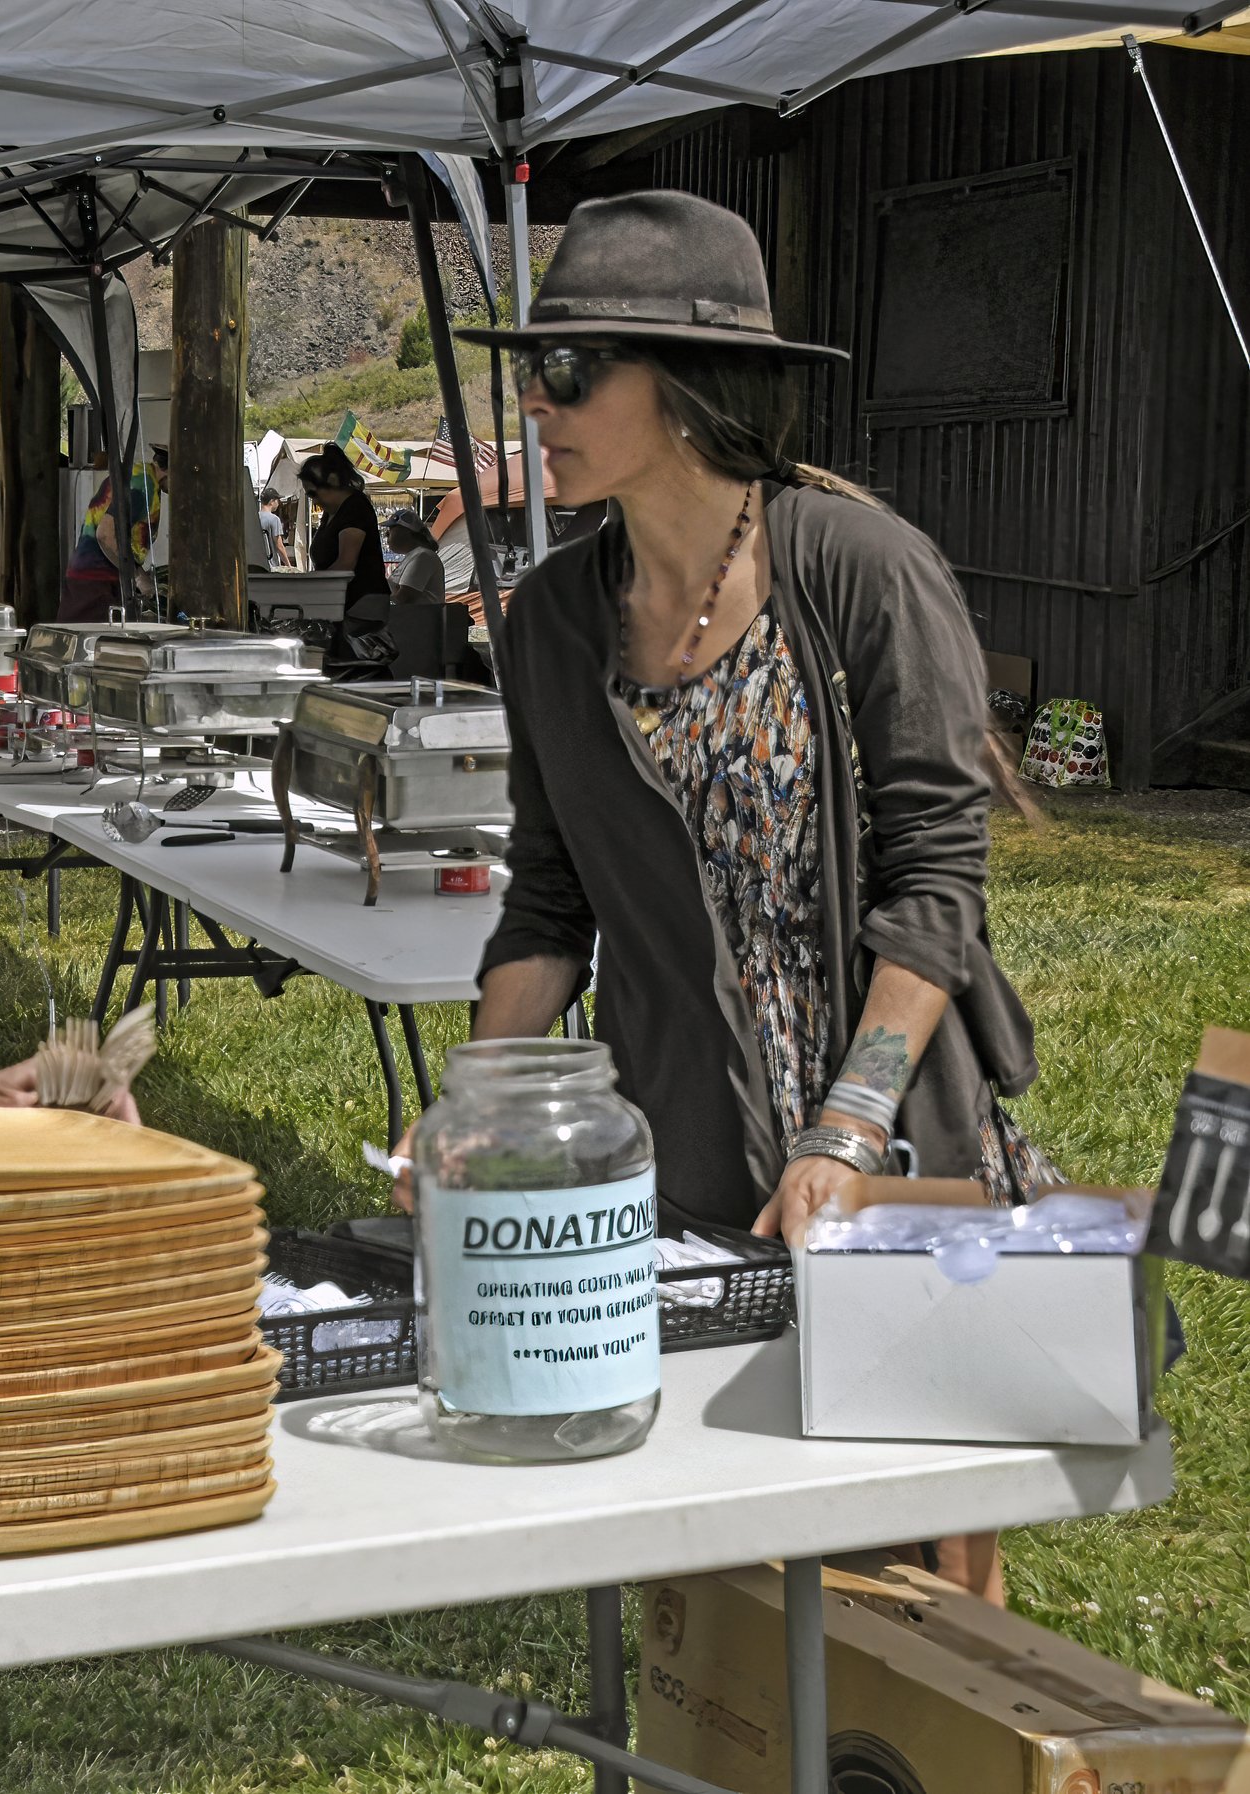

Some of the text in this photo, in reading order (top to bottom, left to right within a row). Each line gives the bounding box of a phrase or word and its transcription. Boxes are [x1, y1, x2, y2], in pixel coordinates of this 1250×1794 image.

[476, 1279, 573, 1299] OPERATING
[578, 1272, 623, 1294] COSTS
[557, 1304, 602, 1325] YOUR
